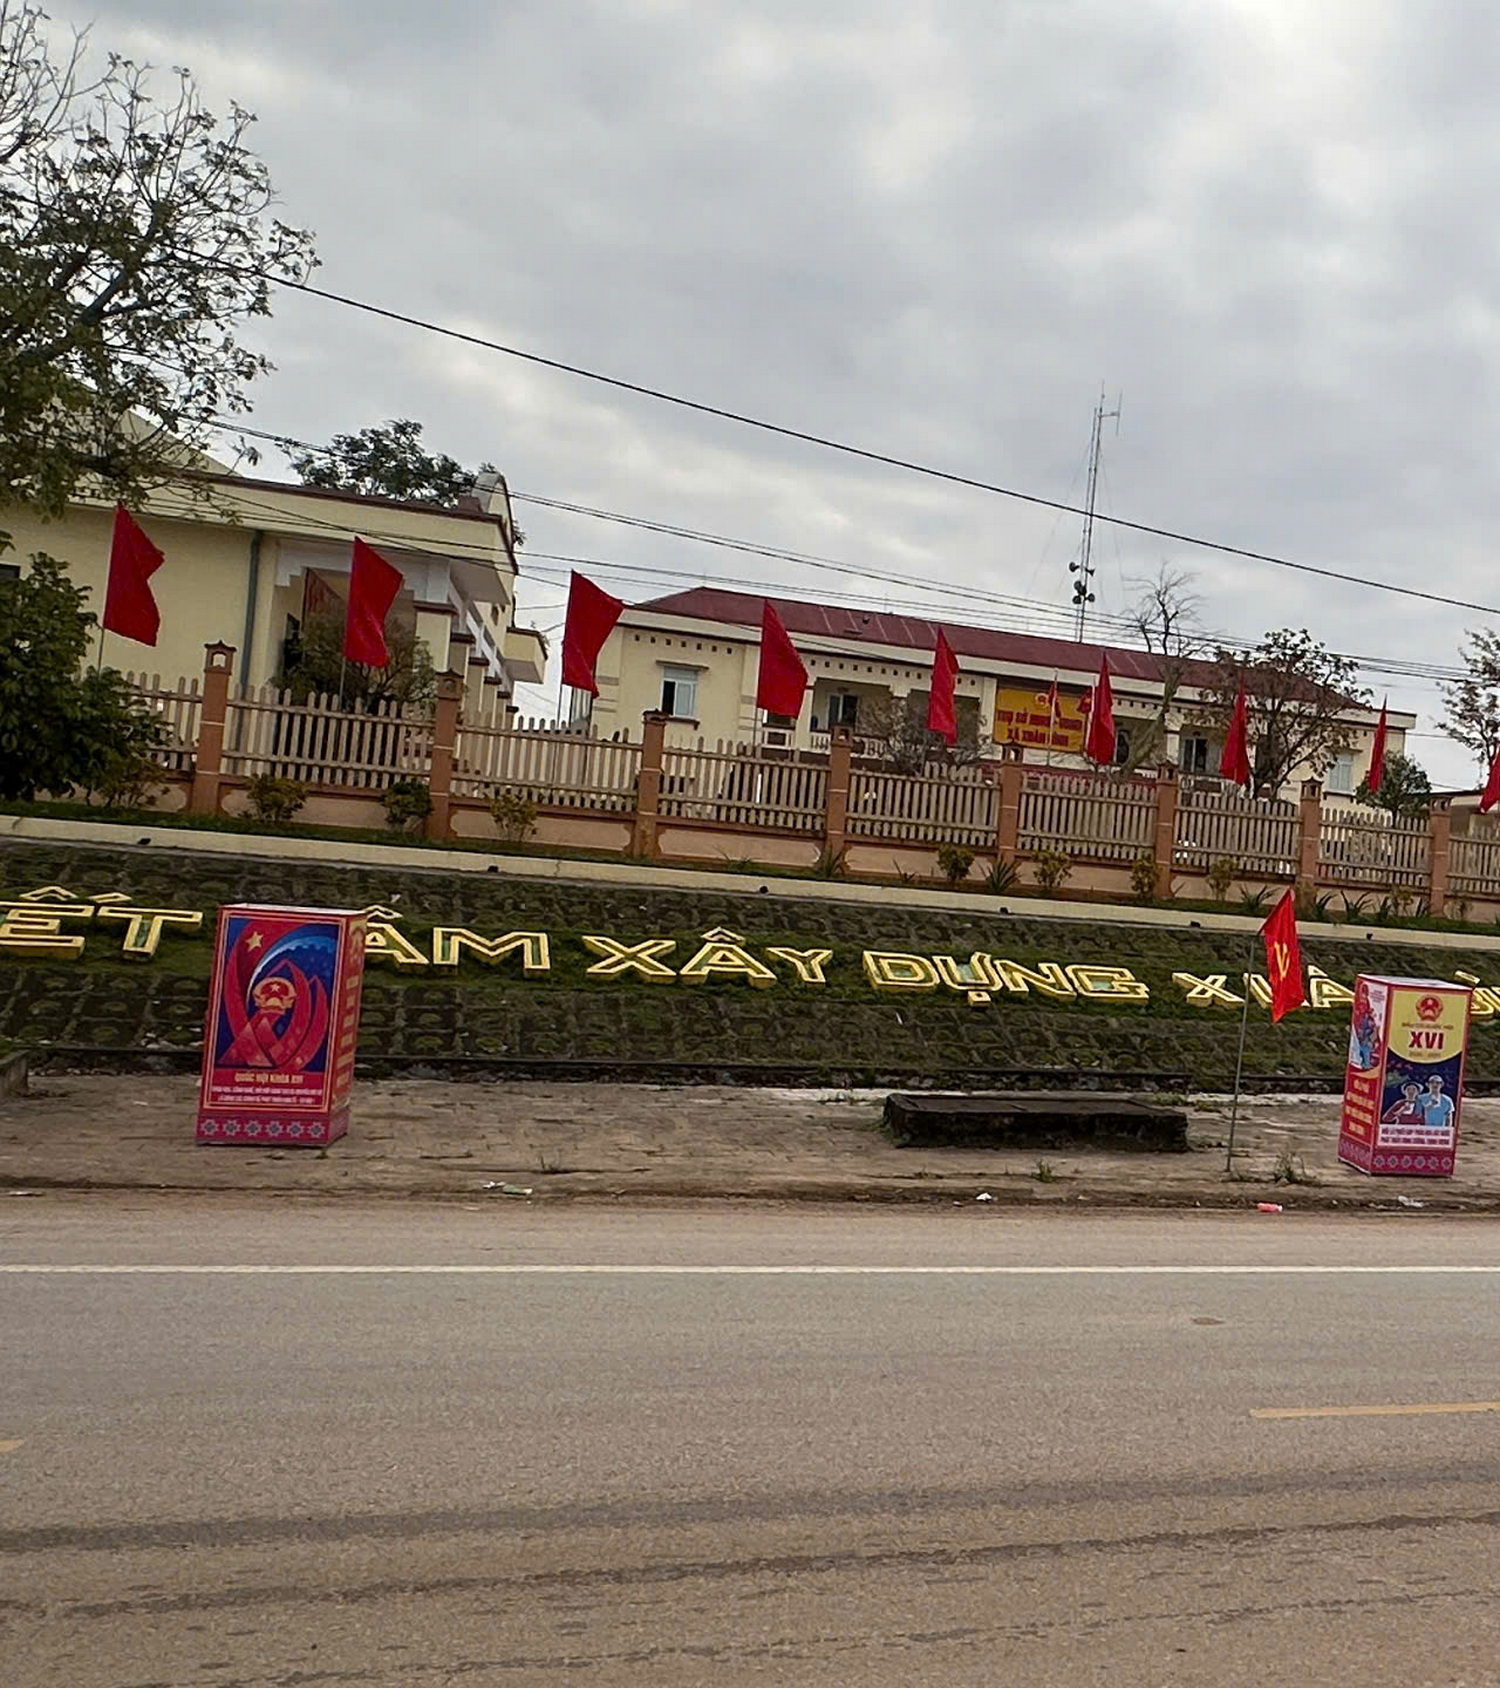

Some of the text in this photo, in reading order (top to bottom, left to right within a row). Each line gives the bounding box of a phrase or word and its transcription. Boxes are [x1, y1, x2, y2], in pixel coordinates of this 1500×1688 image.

[364, 904, 551, 974] ÂM
[582, 926, 833, 987] XÂY
[862, 950, 1150, 1006] DỰNG
[1408, 1031, 1445, 1050] XVI
